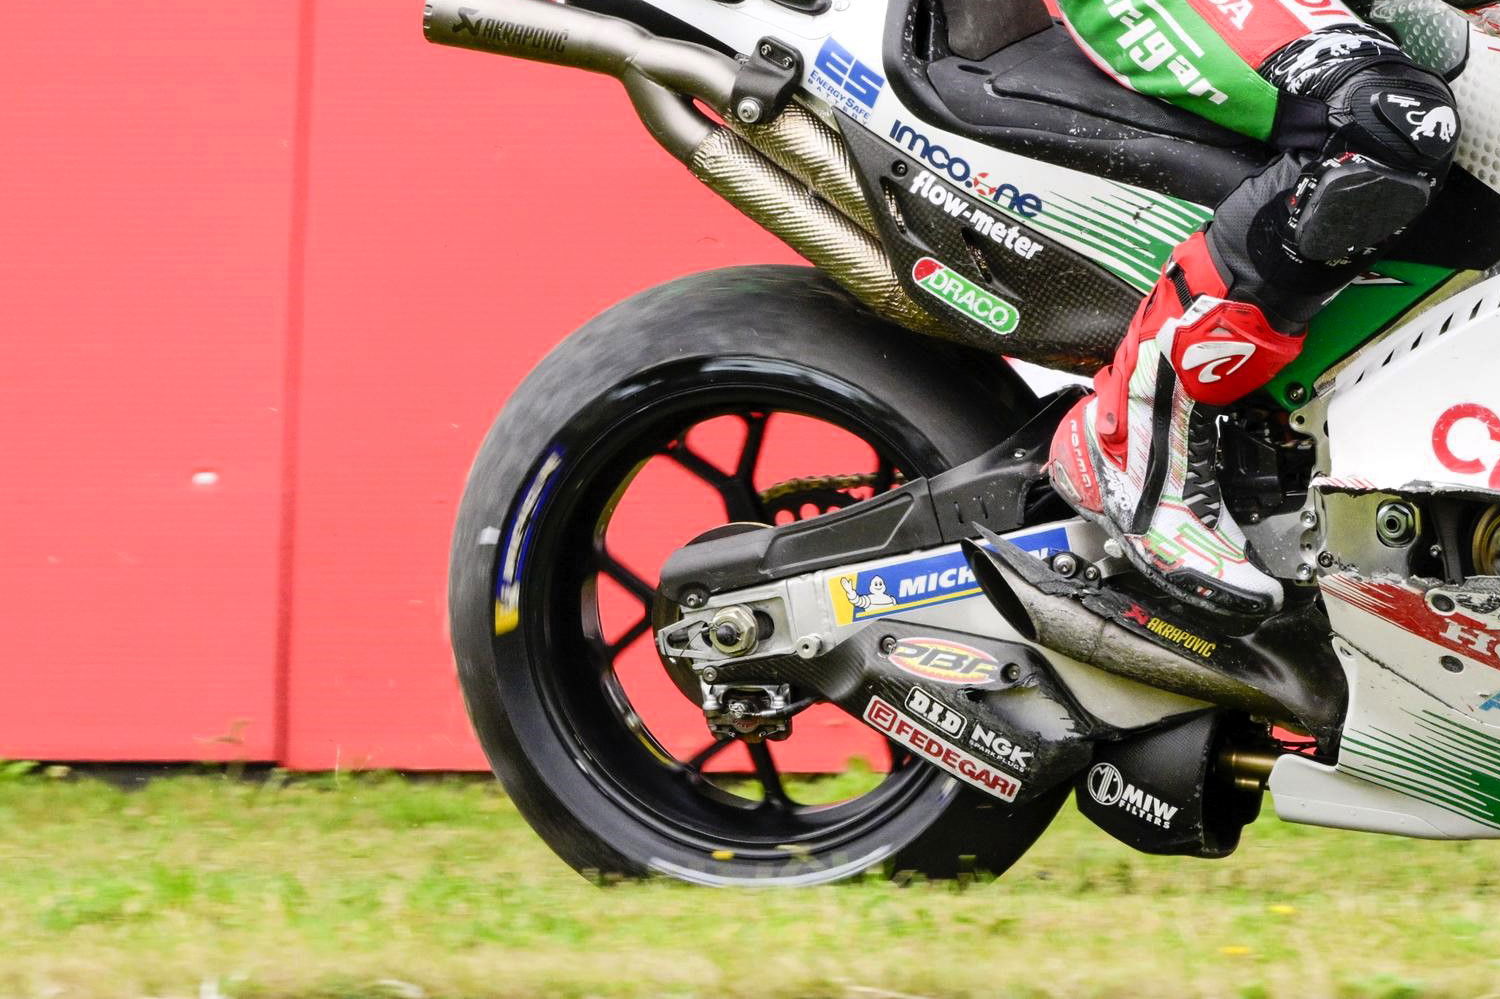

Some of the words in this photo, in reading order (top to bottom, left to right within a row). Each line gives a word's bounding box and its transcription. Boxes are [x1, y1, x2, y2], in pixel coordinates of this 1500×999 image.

[814, 36, 885, 109] ES
[908, 171, 1044, 261] flow-meter
[927, 267, 1009, 327] DRACO
[908, 690, 962, 734] D.I.D
[894, 719, 1017, 798] FEDEGARI
[970, 723, 1034, 769] NGK
[1118, 799, 1170, 830] FILTERS
[1121, 783, 1179, 822] MIW
